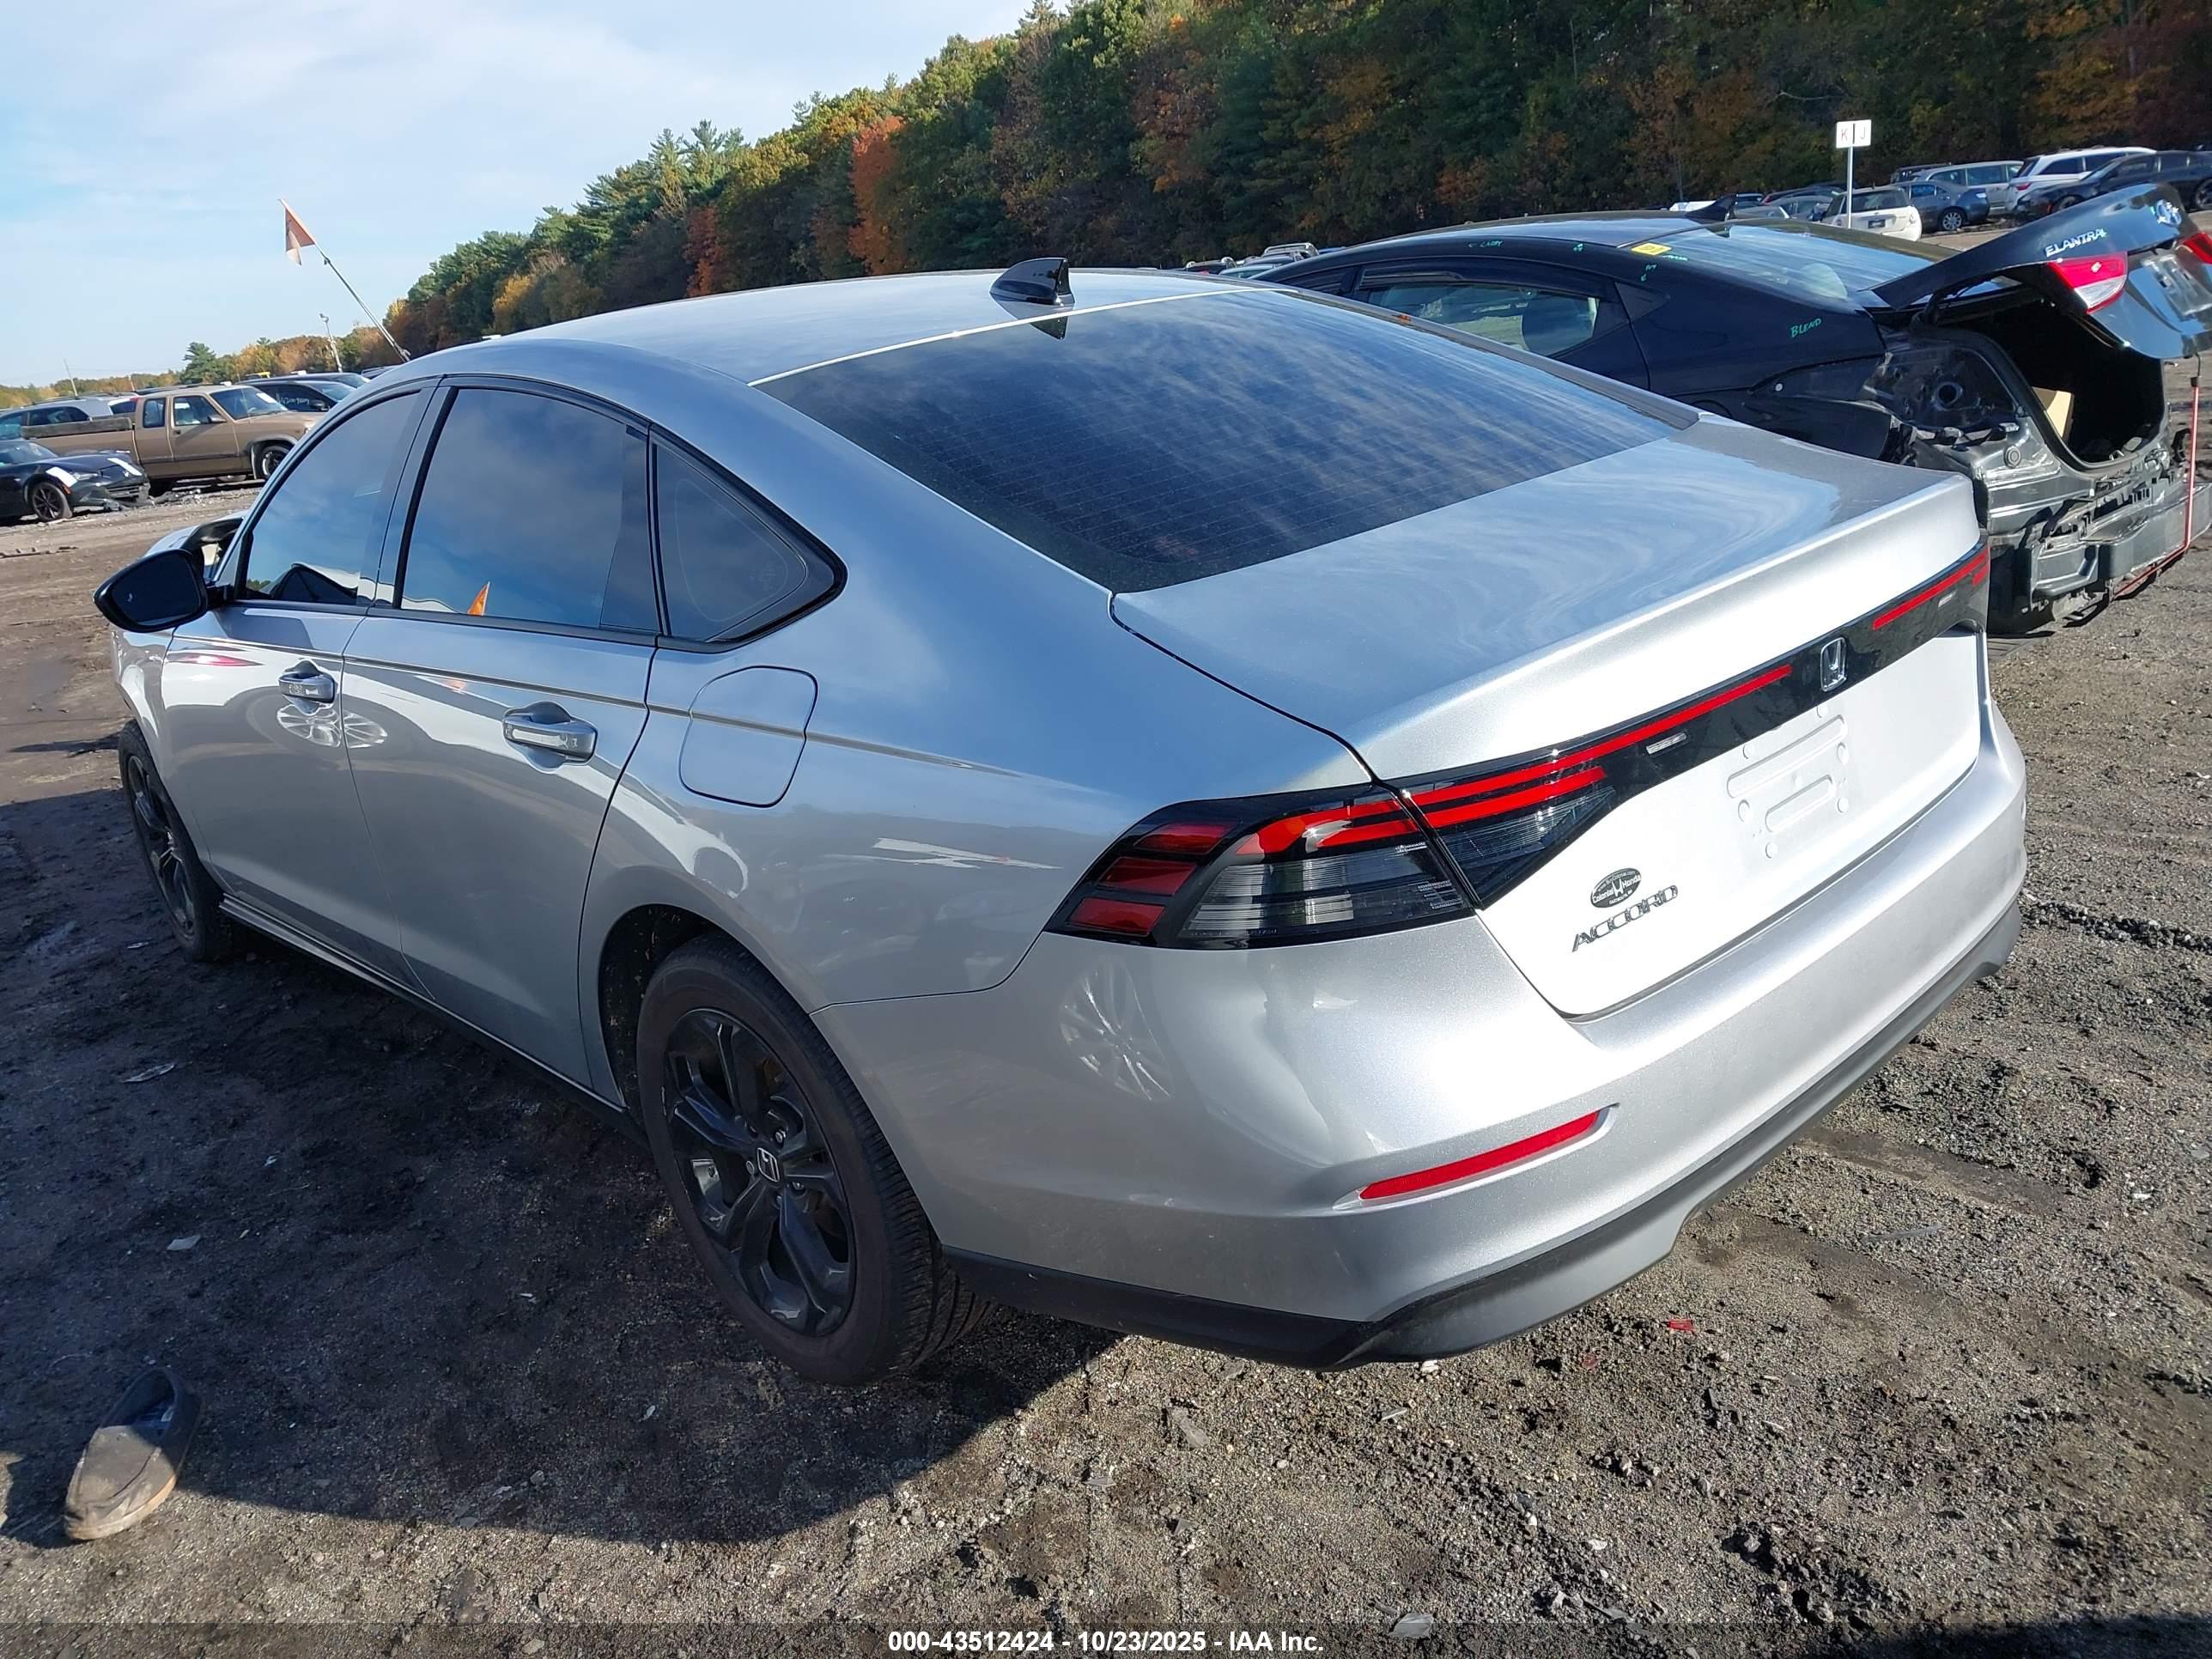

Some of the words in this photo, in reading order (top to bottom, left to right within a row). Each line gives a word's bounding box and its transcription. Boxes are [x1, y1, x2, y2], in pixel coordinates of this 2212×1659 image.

[1840, 127, 1848, 142] K
[1860, 125, 1866, 140] J
[2045, 228, 2106, 258] ELANTRA
[1790, 318, 1822, 338] BLEND
[1593, 887, 1615, 903] Colonial
[1621, 874, 1642, 889] Honda
[1571, 884, 1679, 953] ACCORD
